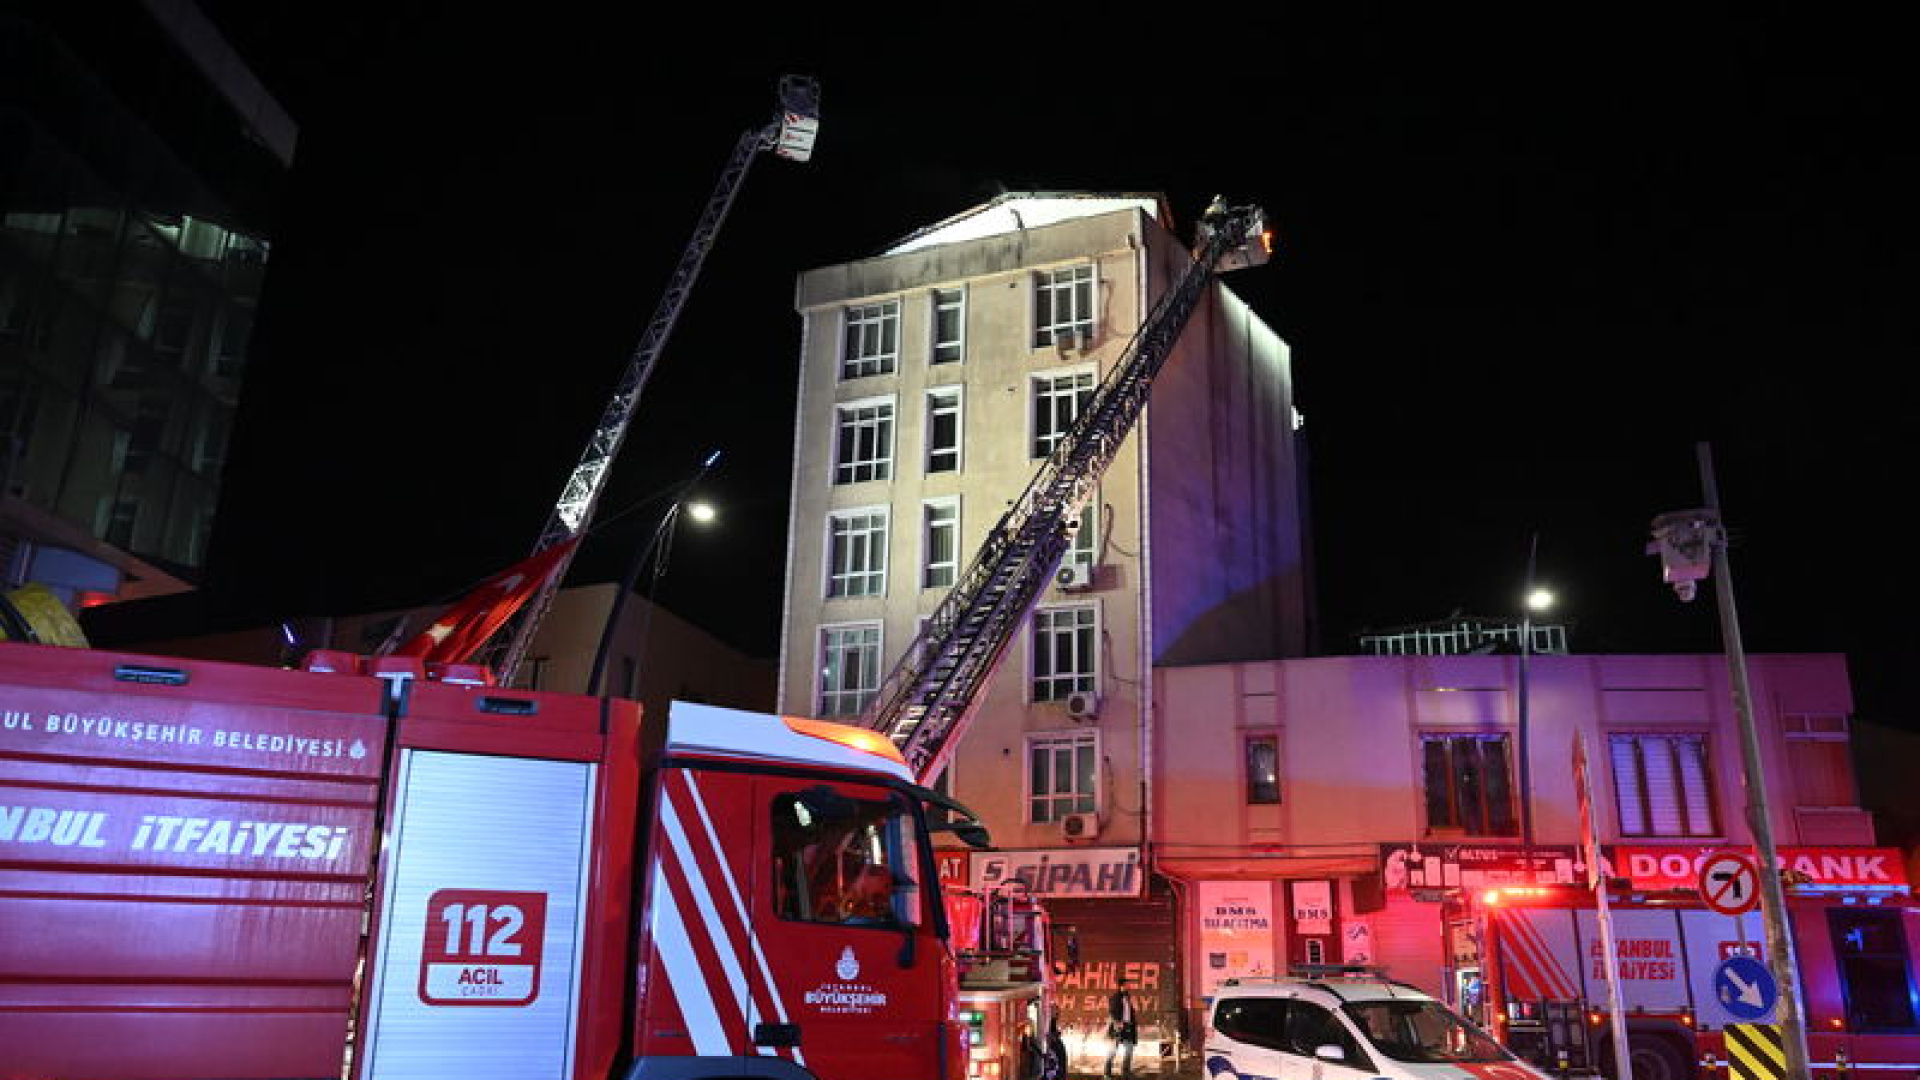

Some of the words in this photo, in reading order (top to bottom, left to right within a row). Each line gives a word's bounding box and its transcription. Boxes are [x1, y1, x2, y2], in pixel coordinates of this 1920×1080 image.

[0, 710, 33, 730] UL
[46, 713, 202, 745] BÜYÜKŞEHİR
[213, 729, 343, 757] BELEDİYESİ
[441, 903, 524, 956] 112
